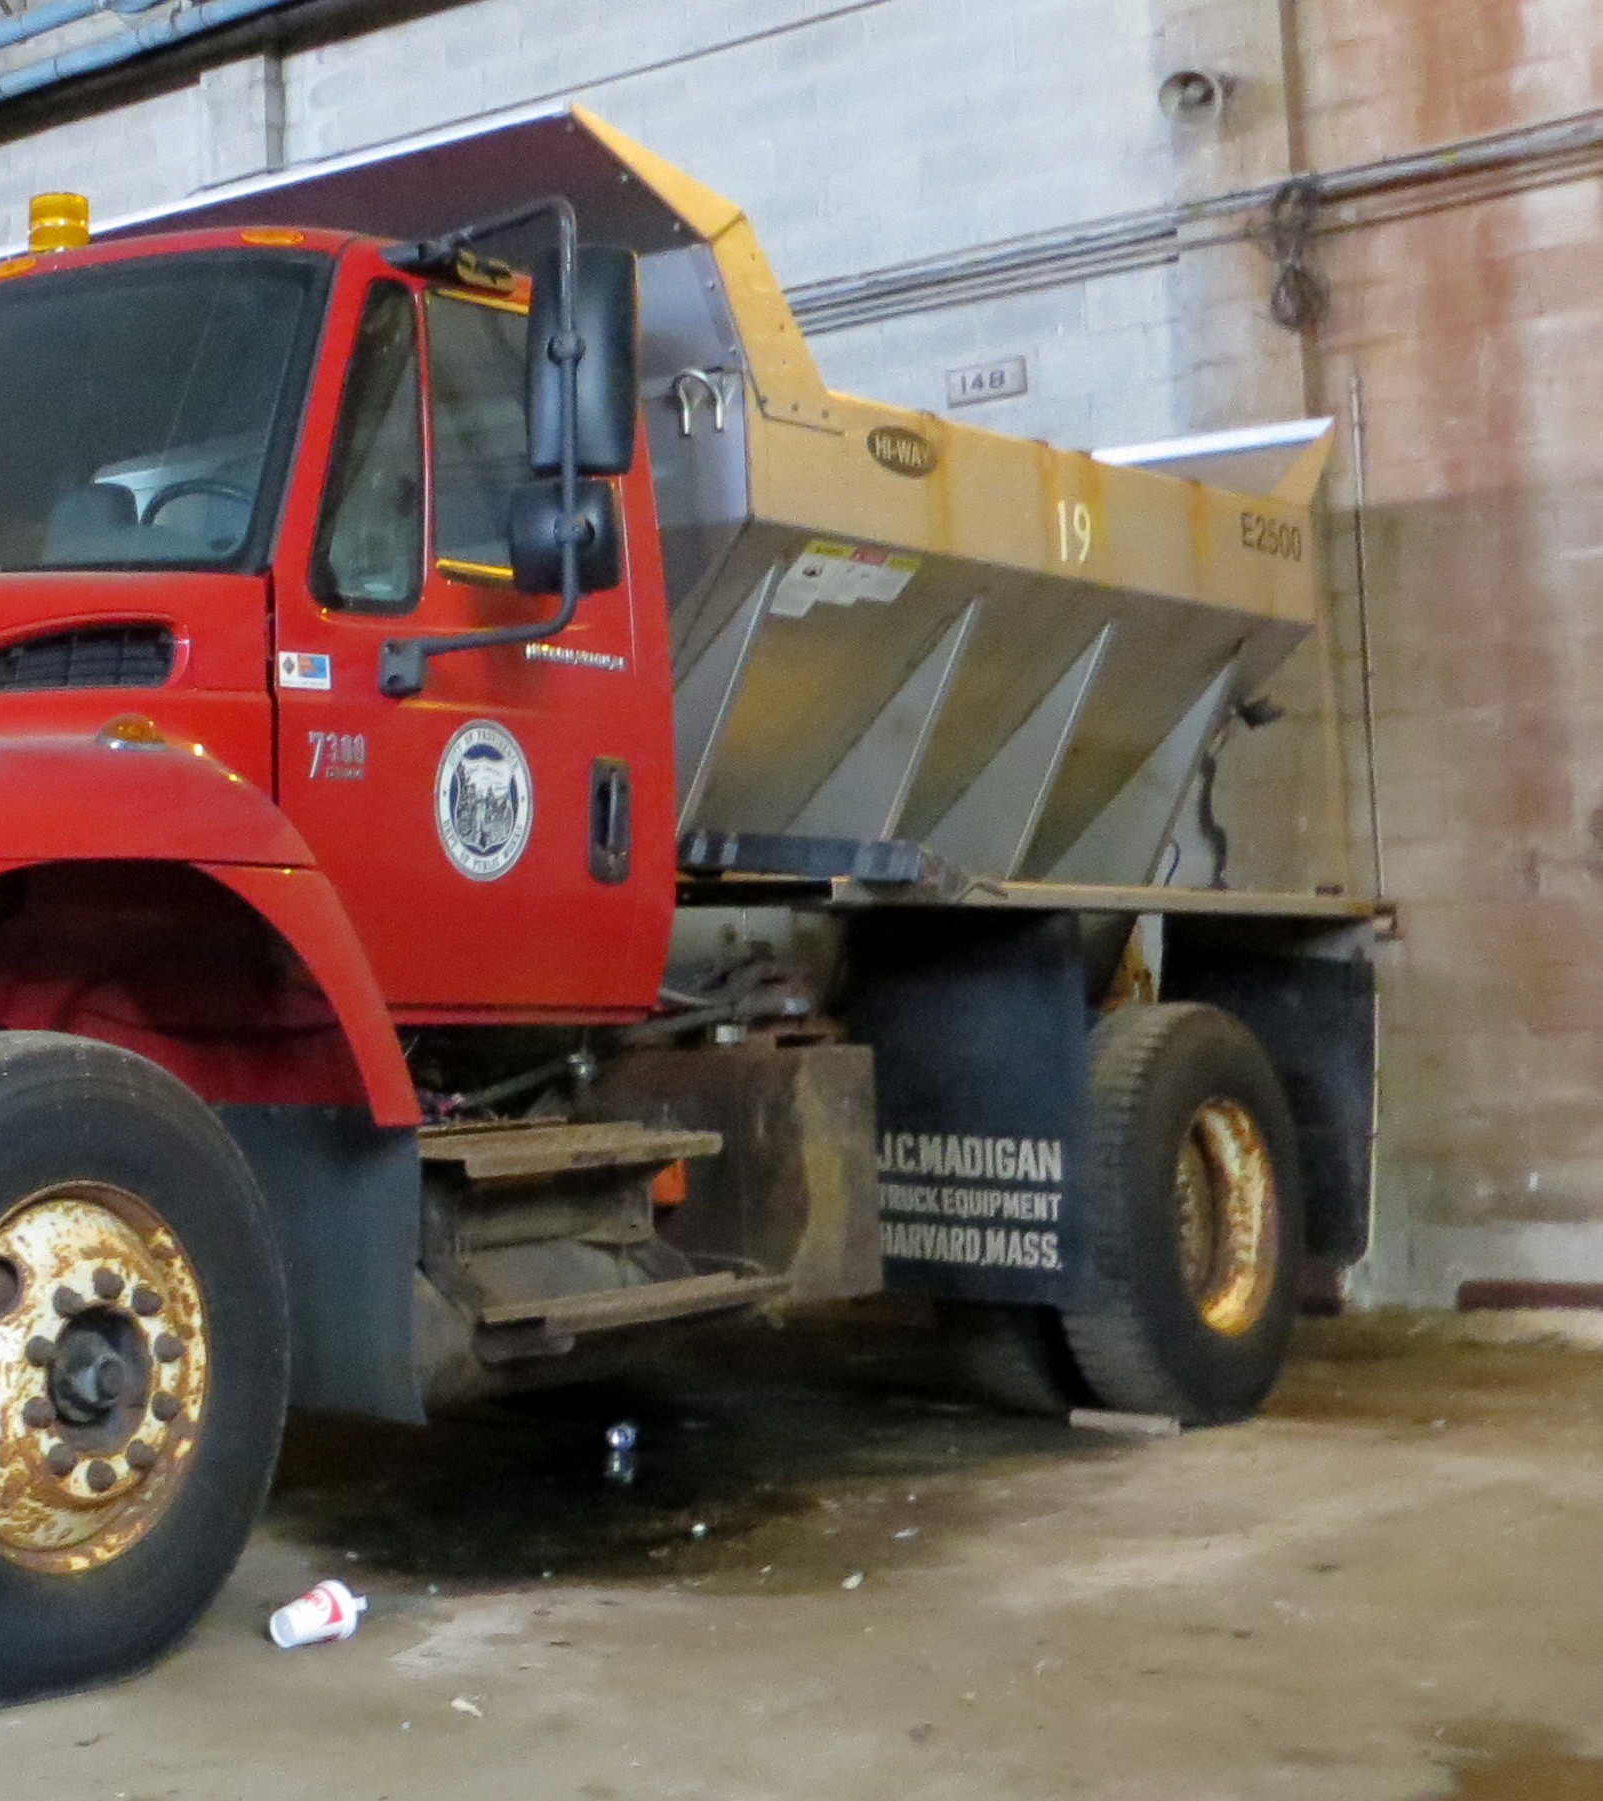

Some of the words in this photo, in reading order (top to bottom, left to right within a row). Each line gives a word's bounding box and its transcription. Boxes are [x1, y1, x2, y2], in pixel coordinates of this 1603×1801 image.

[1057, 499, 1091, 564] 19
[1240, 511, 1302, 562] E2500
[941, 1186, 1063, 1222] EQUIPMENT
